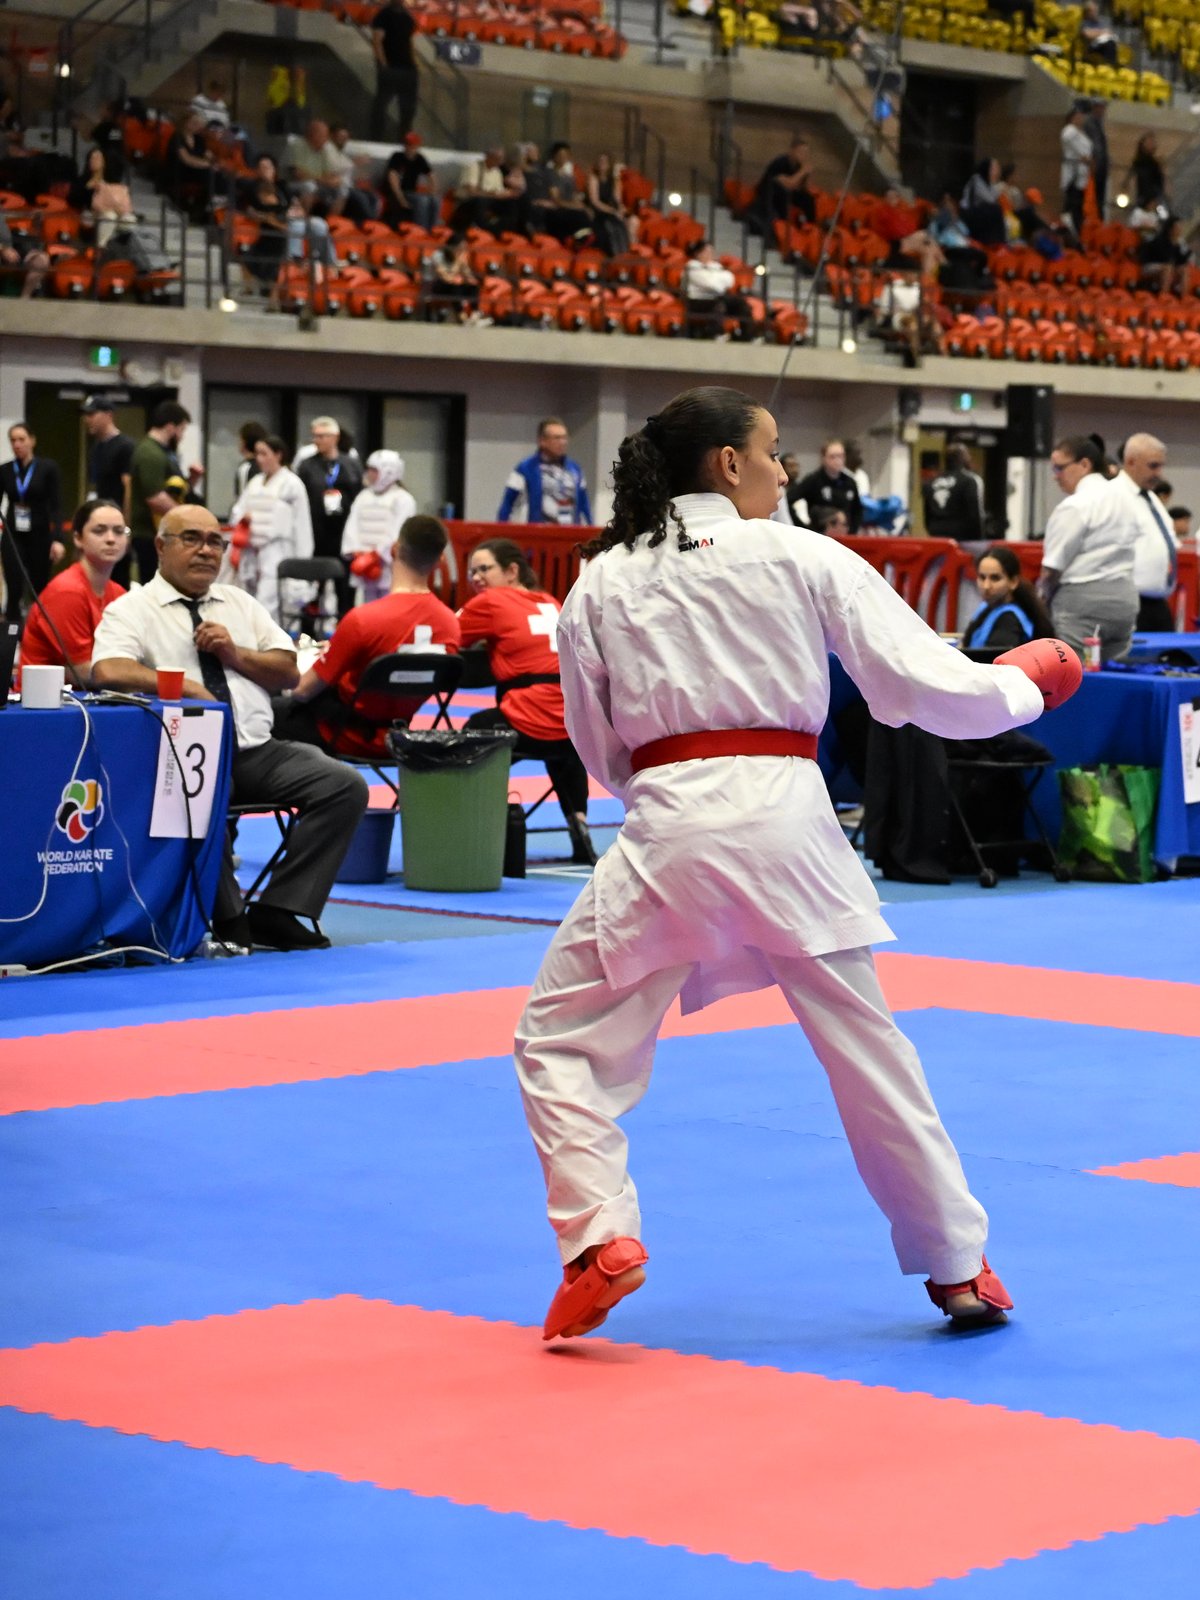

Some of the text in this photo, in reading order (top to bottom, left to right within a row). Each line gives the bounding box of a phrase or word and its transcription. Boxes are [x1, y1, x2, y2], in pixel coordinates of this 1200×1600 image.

[678, 537, 714, 552] SMAI
[182, 743, 206, 798] 3
[37, 848, 113, 863] WORLD KARATE
[43, 861, 104, 875] FEDERATION
